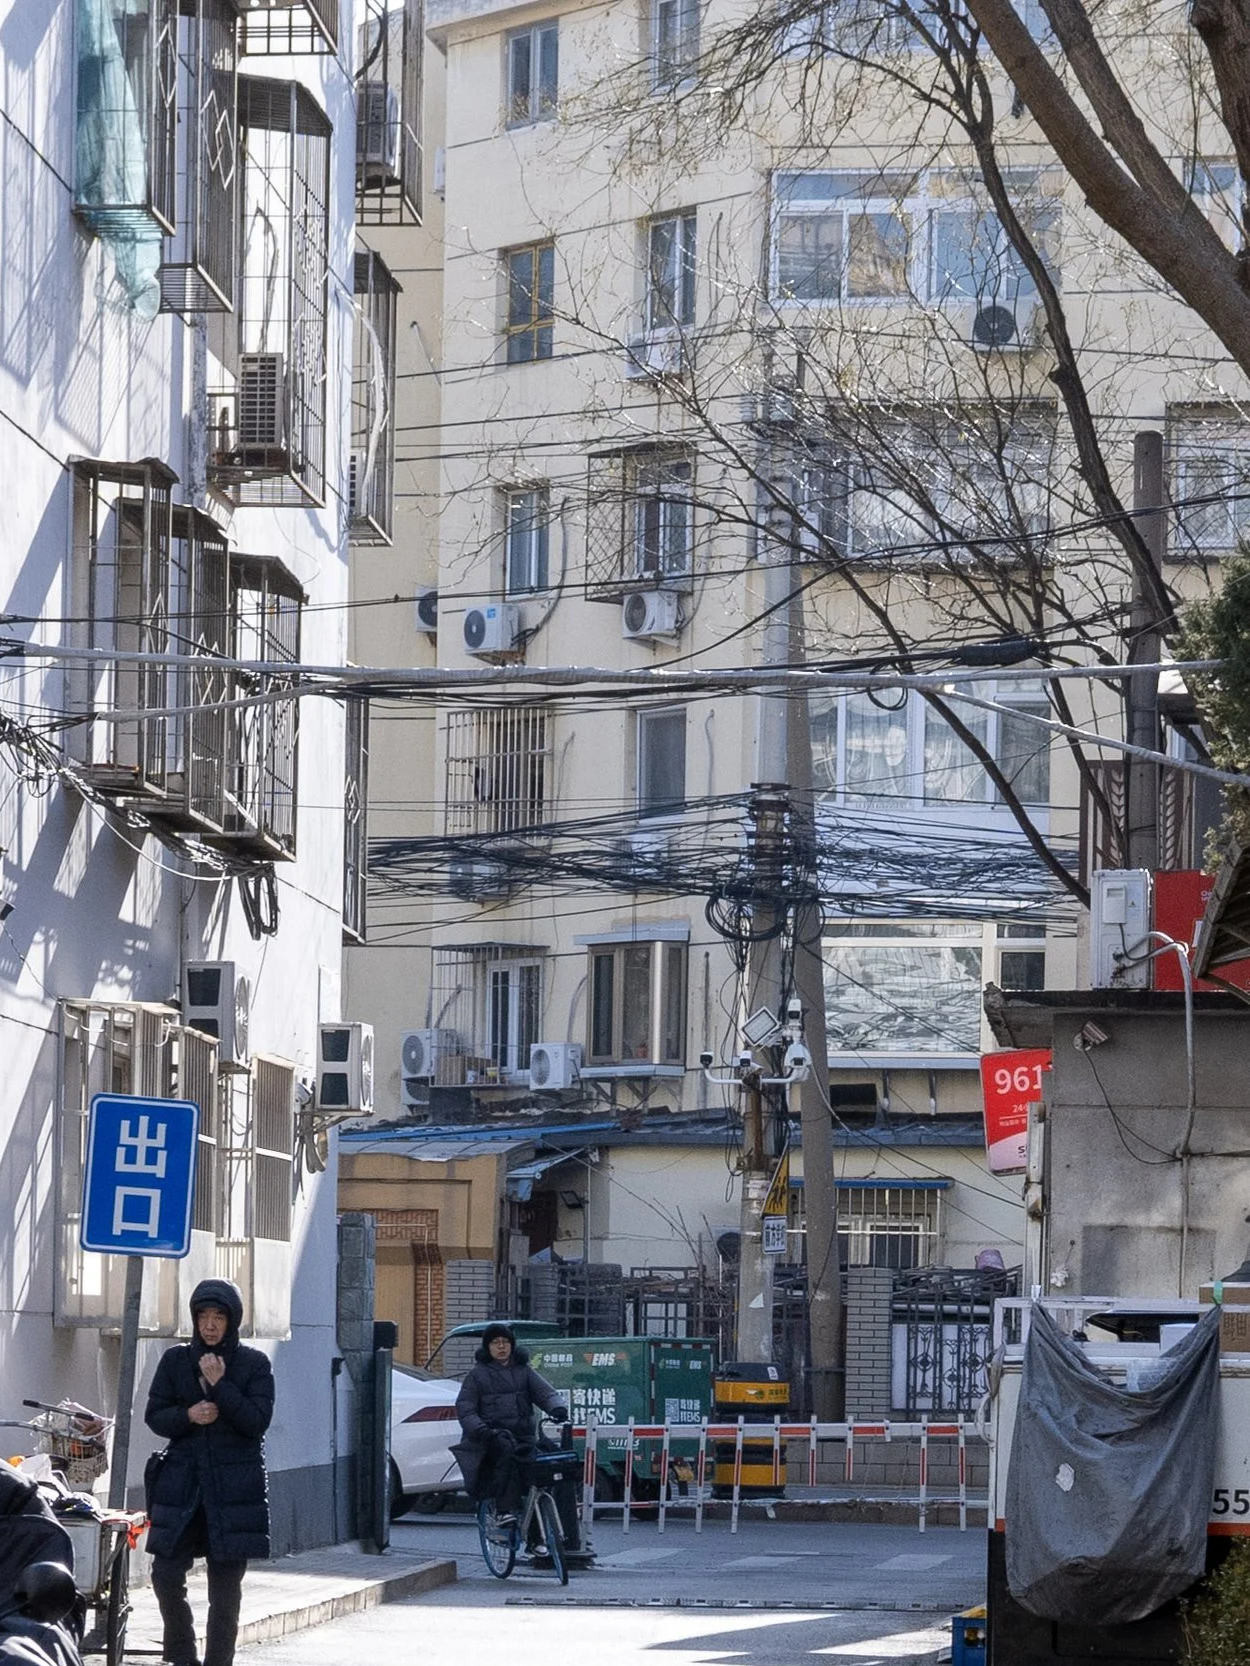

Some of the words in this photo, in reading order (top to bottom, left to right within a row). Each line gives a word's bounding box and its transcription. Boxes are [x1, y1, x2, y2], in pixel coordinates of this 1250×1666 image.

[995, 1065, 1052, 1094] 961
[112, 1115, 168, 1238] 出口
[592, 1353, 616, 1366] EMS
[573, 1388, 616, 1406] 寄快递
